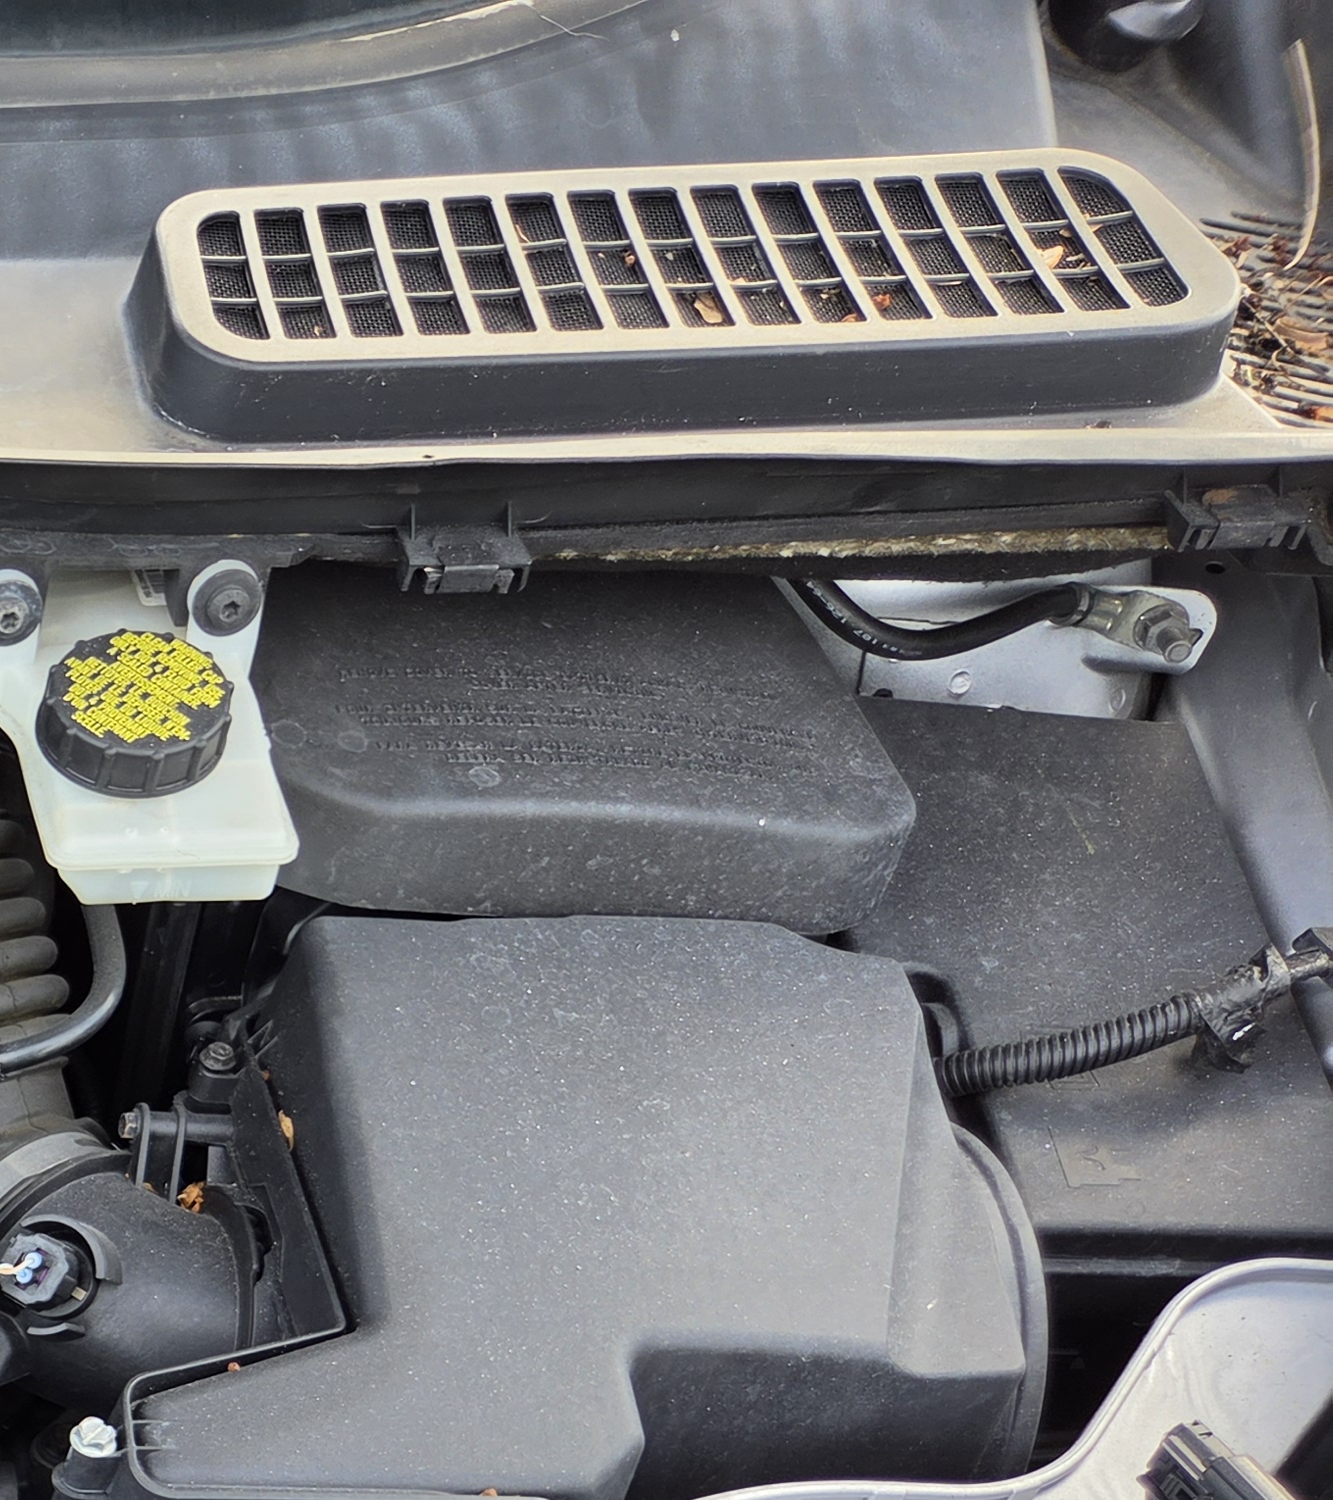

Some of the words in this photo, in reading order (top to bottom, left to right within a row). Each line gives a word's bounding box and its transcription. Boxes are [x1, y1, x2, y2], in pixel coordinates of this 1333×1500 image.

[118, 652, 151, 677] SEALED
[132, 650, 155, 667] DOT
[189, 687, 219, 707] FROM
[141, 633, 173, 653] CLEAN
[170, 650, 204, 673] FILLER
[200, 669, 221, 686] CAP
